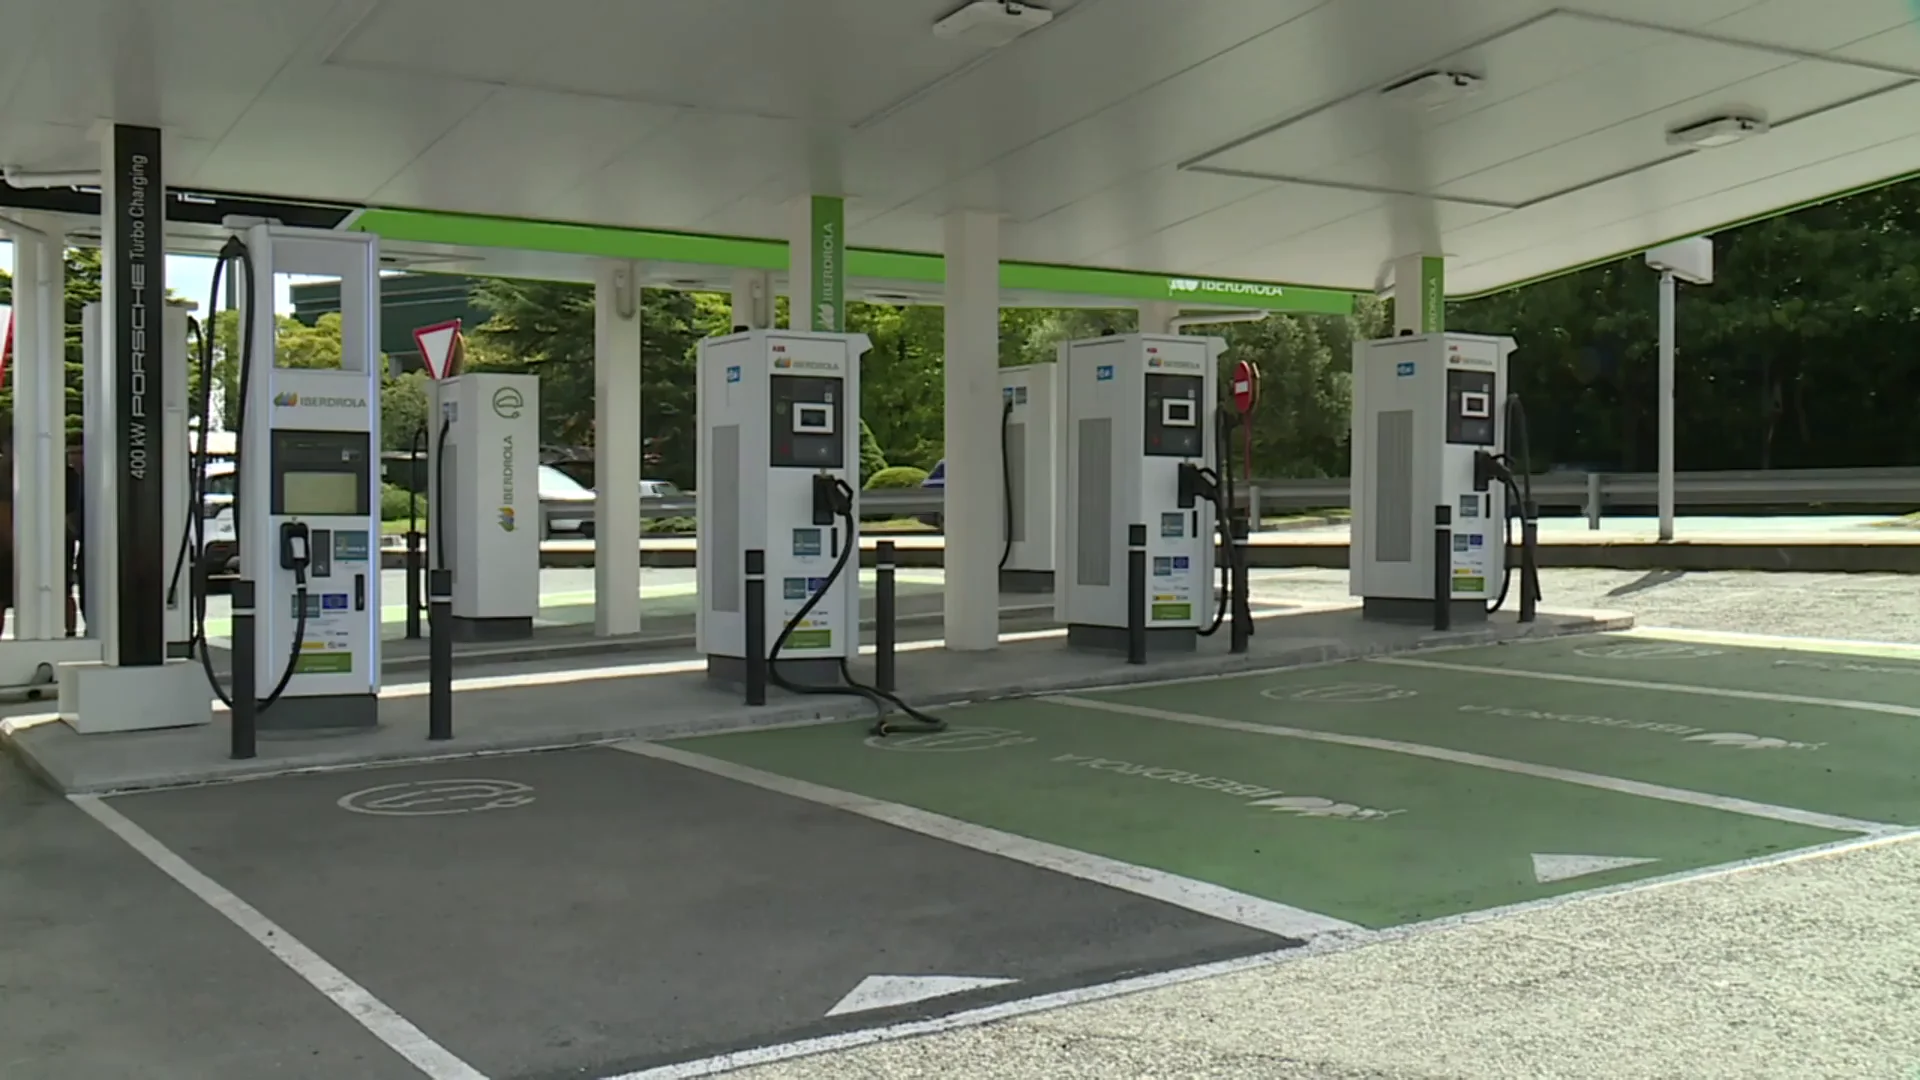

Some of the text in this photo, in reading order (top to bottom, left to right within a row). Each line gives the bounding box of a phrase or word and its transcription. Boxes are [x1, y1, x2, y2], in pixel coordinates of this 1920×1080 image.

[823, 223, 834, 301] IBERDROLA
[128, 154, 149, 480] 400 kW PORSCHE Turbo Charging
[300, 397, 367, 408] IBERDROLA
[503, 435, 514, 504] IBERDROLA
